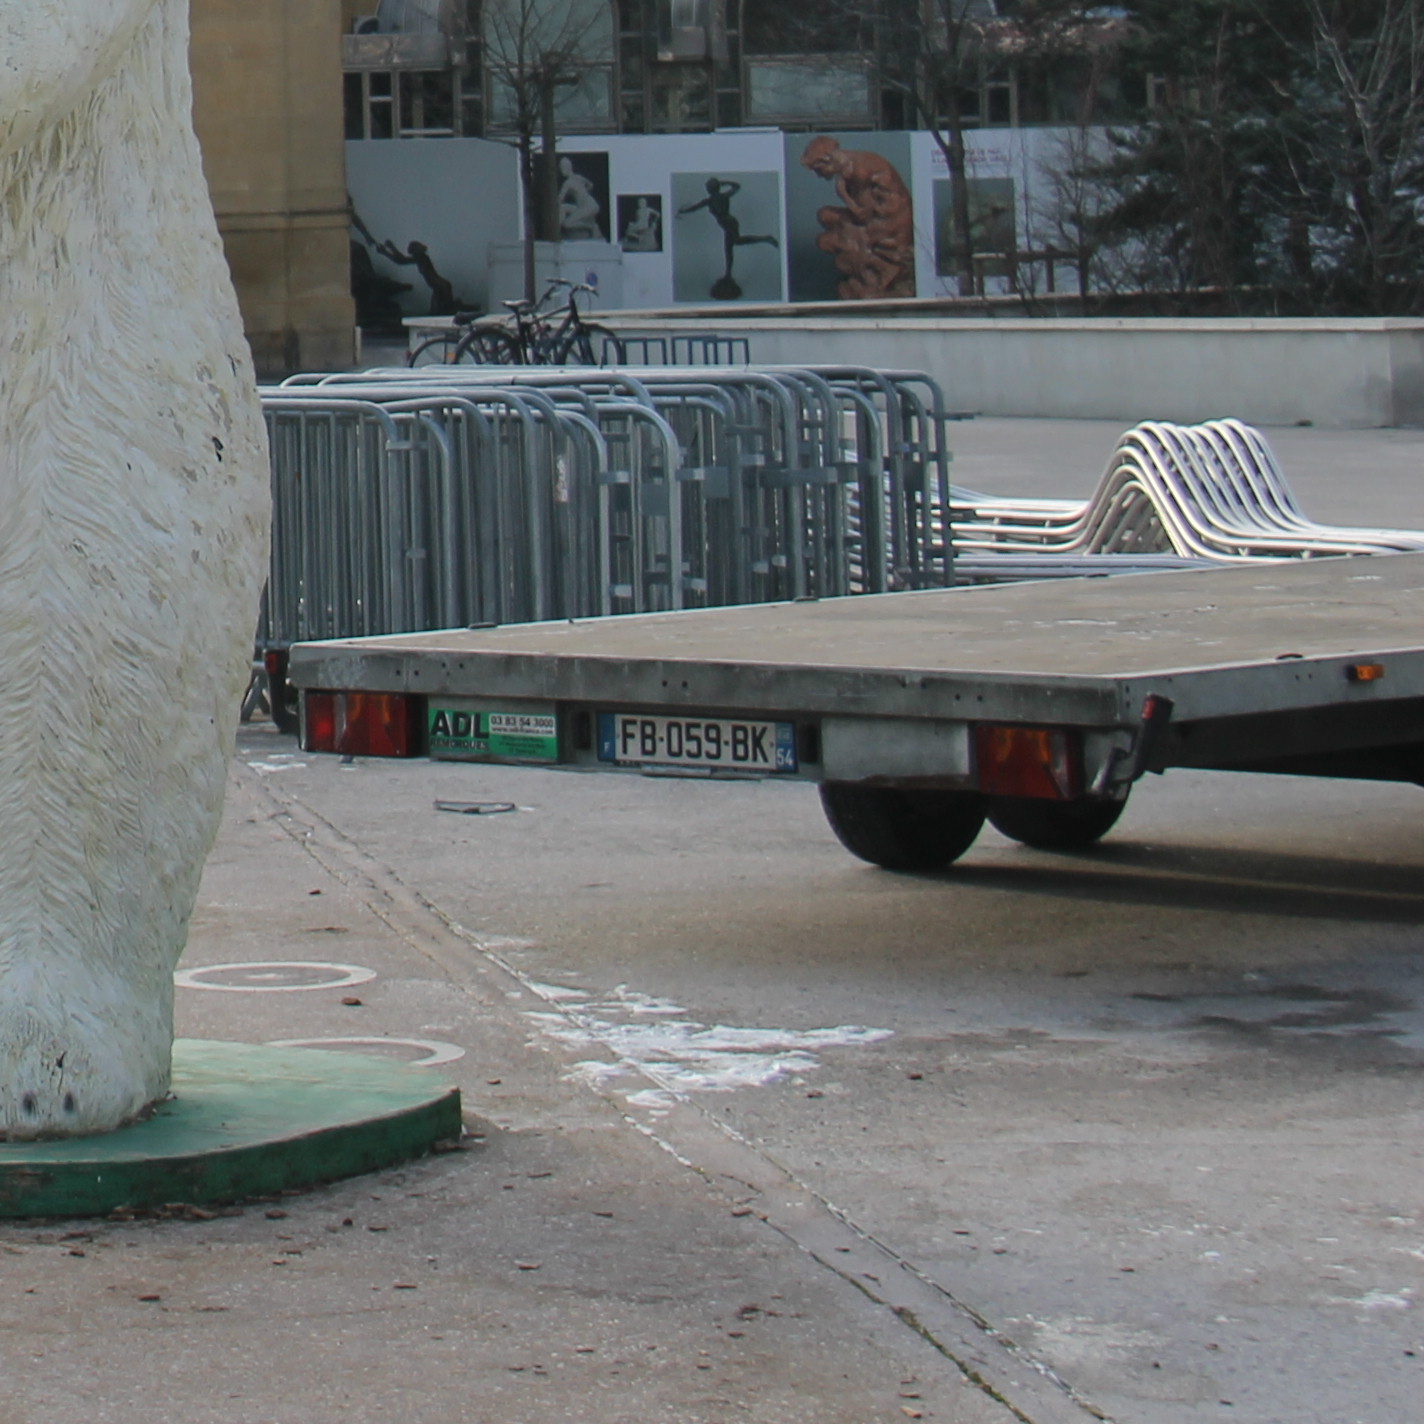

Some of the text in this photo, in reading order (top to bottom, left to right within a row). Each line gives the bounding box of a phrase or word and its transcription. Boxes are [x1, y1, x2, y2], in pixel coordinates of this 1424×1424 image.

[431, 709, 490, 740] ADL
[491, 715, 503, 726] 03
[504, 716, 517, 727] 83
[519, 716, 531, 727] 54
[604, 741, 611, 753] F
[621, 718, 769, 763] FB-059-BK
[776, 748, 794, 767] 54
